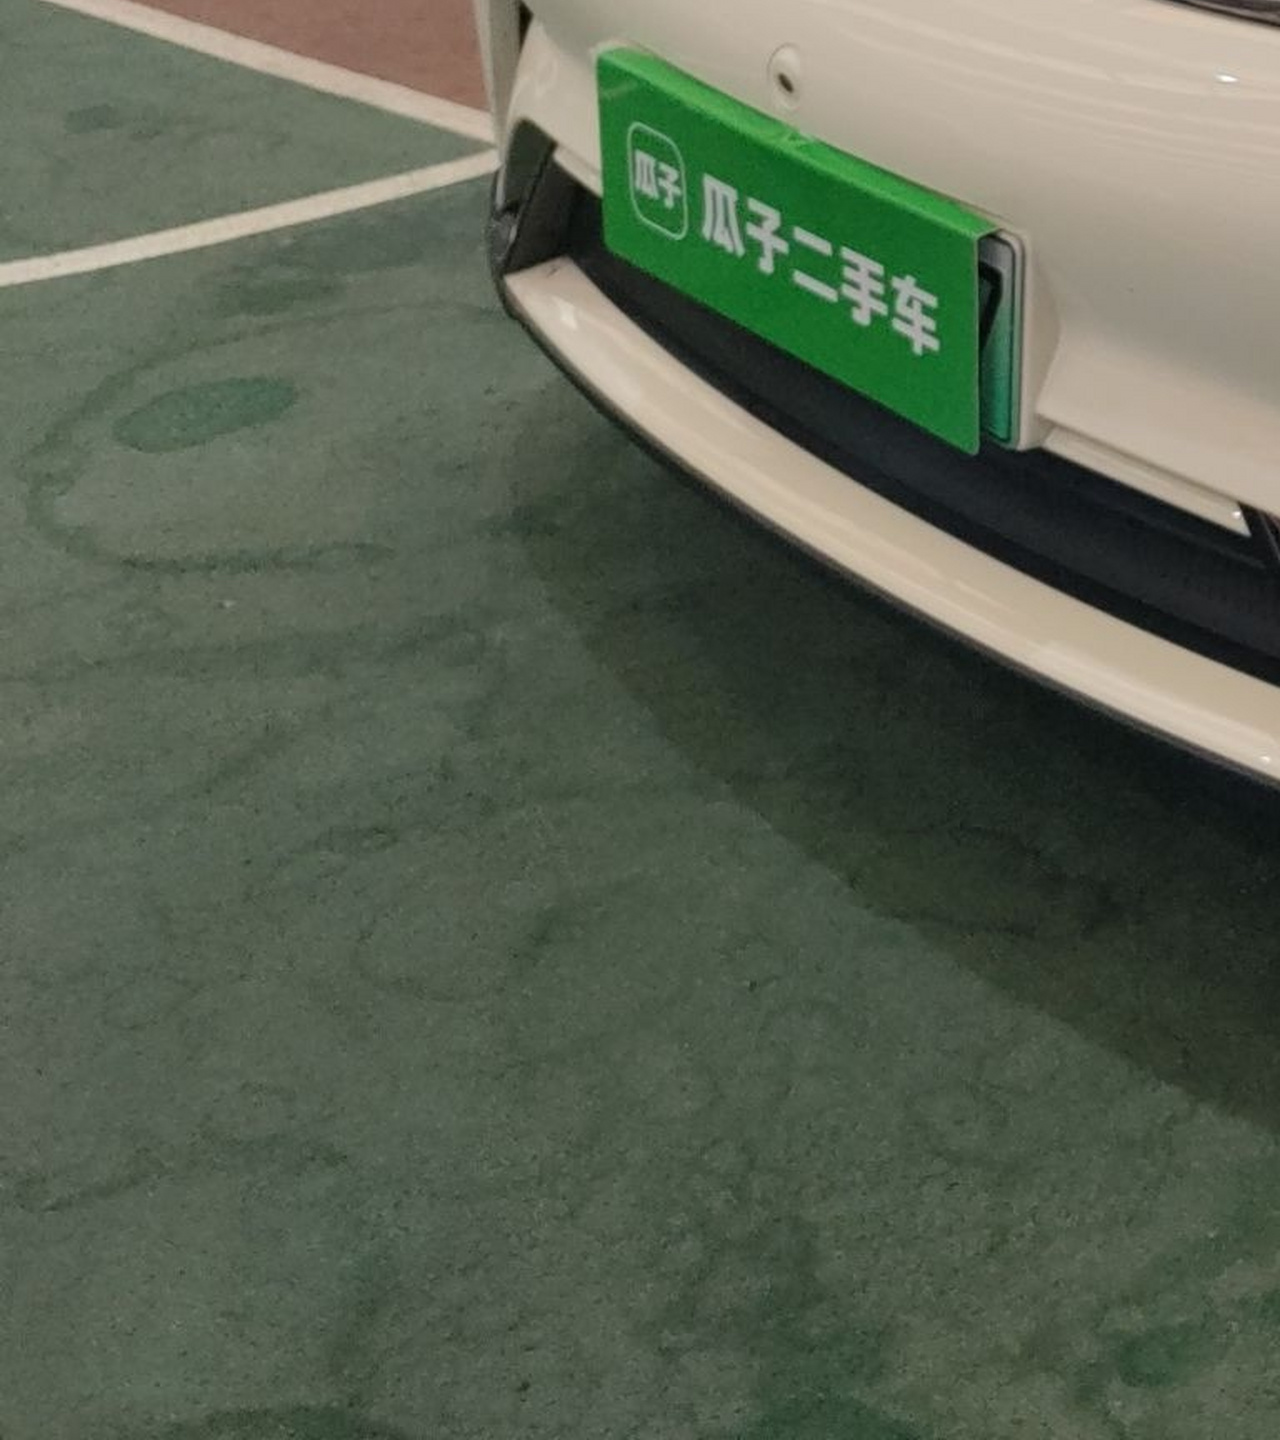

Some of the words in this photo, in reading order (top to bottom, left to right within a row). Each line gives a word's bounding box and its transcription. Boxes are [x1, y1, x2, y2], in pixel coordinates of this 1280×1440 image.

[633, 149, 682, 209] 瓜子
[702, 173, 940, 357] 瓜子二手车
